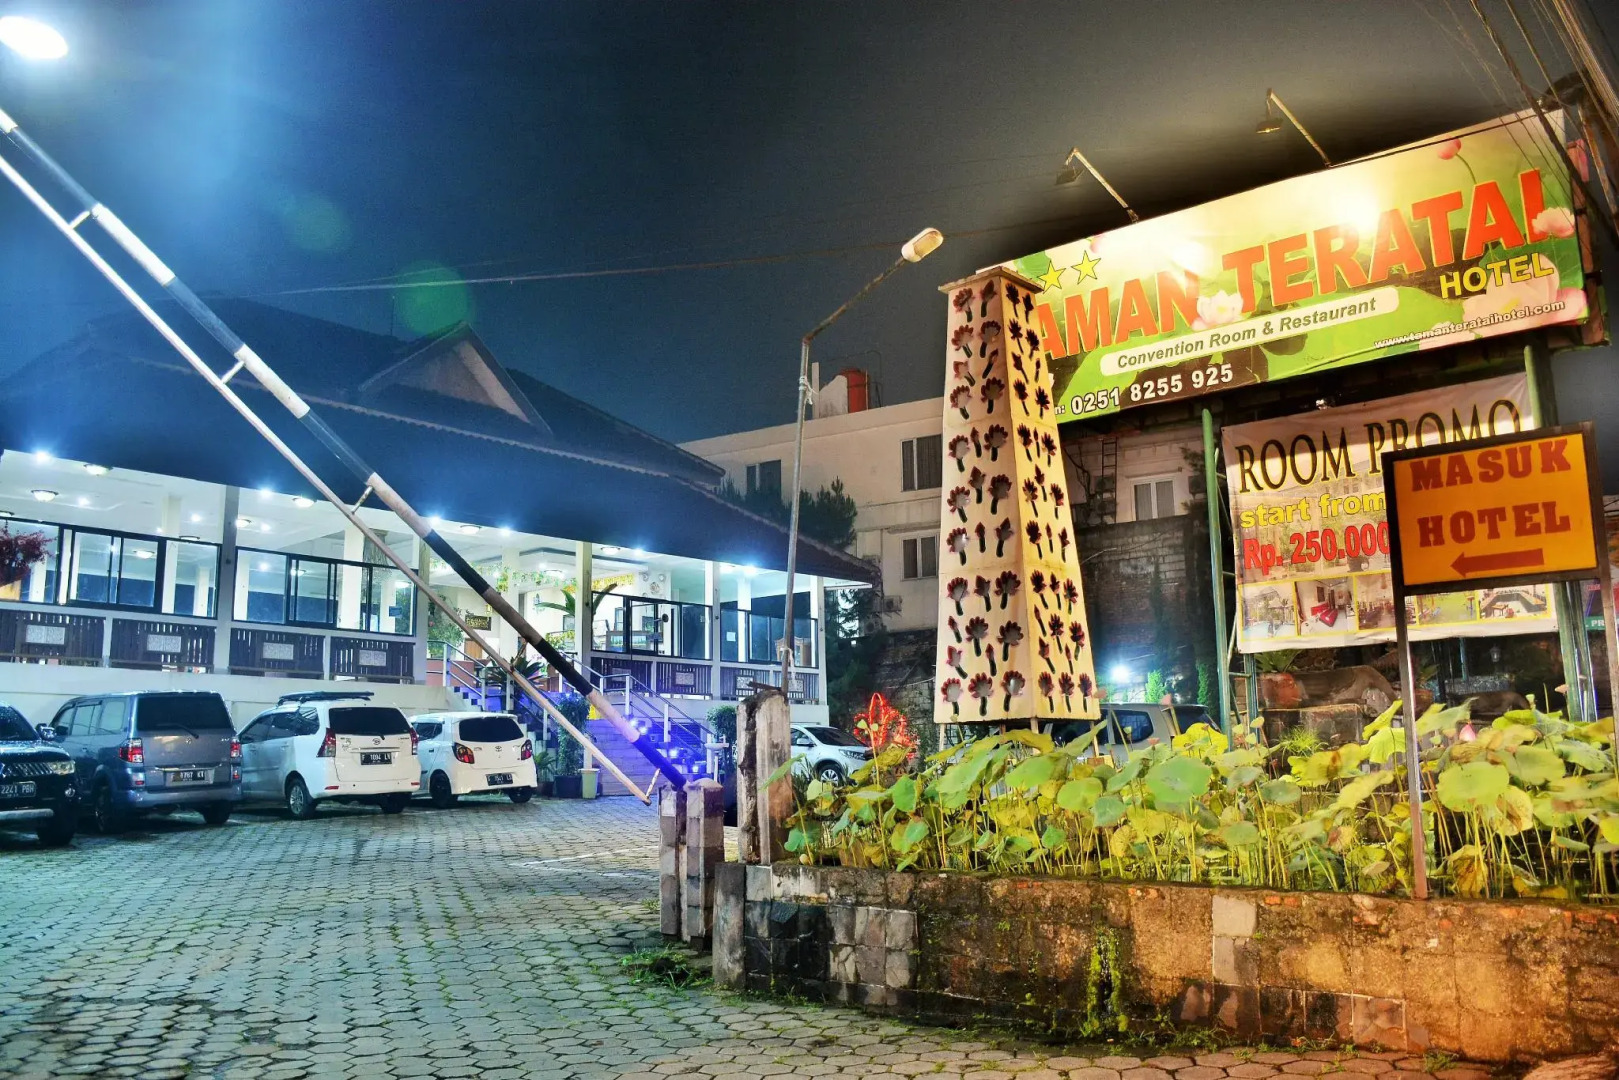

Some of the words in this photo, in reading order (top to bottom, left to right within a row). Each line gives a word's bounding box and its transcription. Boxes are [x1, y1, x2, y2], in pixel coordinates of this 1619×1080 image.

[1036, 269, 1200, 360] AMAN
[1221, 168, 1549, 314] TERATAI
[1439, 252, 1554, 299] HOTEL
[1117, 338, 1204, 369] Convention
[1209, 326, 1257, 348] Room
[1262, 319, 1274, 335] &
[1279, 297, 1377, 331] Restaurant
[1071, 387, 1120, 415] 0251
[1130, 374, 1183, 402] 8255
[1191, 363, 1234, 389] 925
[1235, 427, 1356, 494] ROOM
[1409, 438, 1571, 492] MASUK
[1240, 497, 1311, 528] start
[1319, 492, 1386, 518] from
[1417, 501, 1571, 547] HOTEL
[1243, 538, 1284, 576] Rp.
